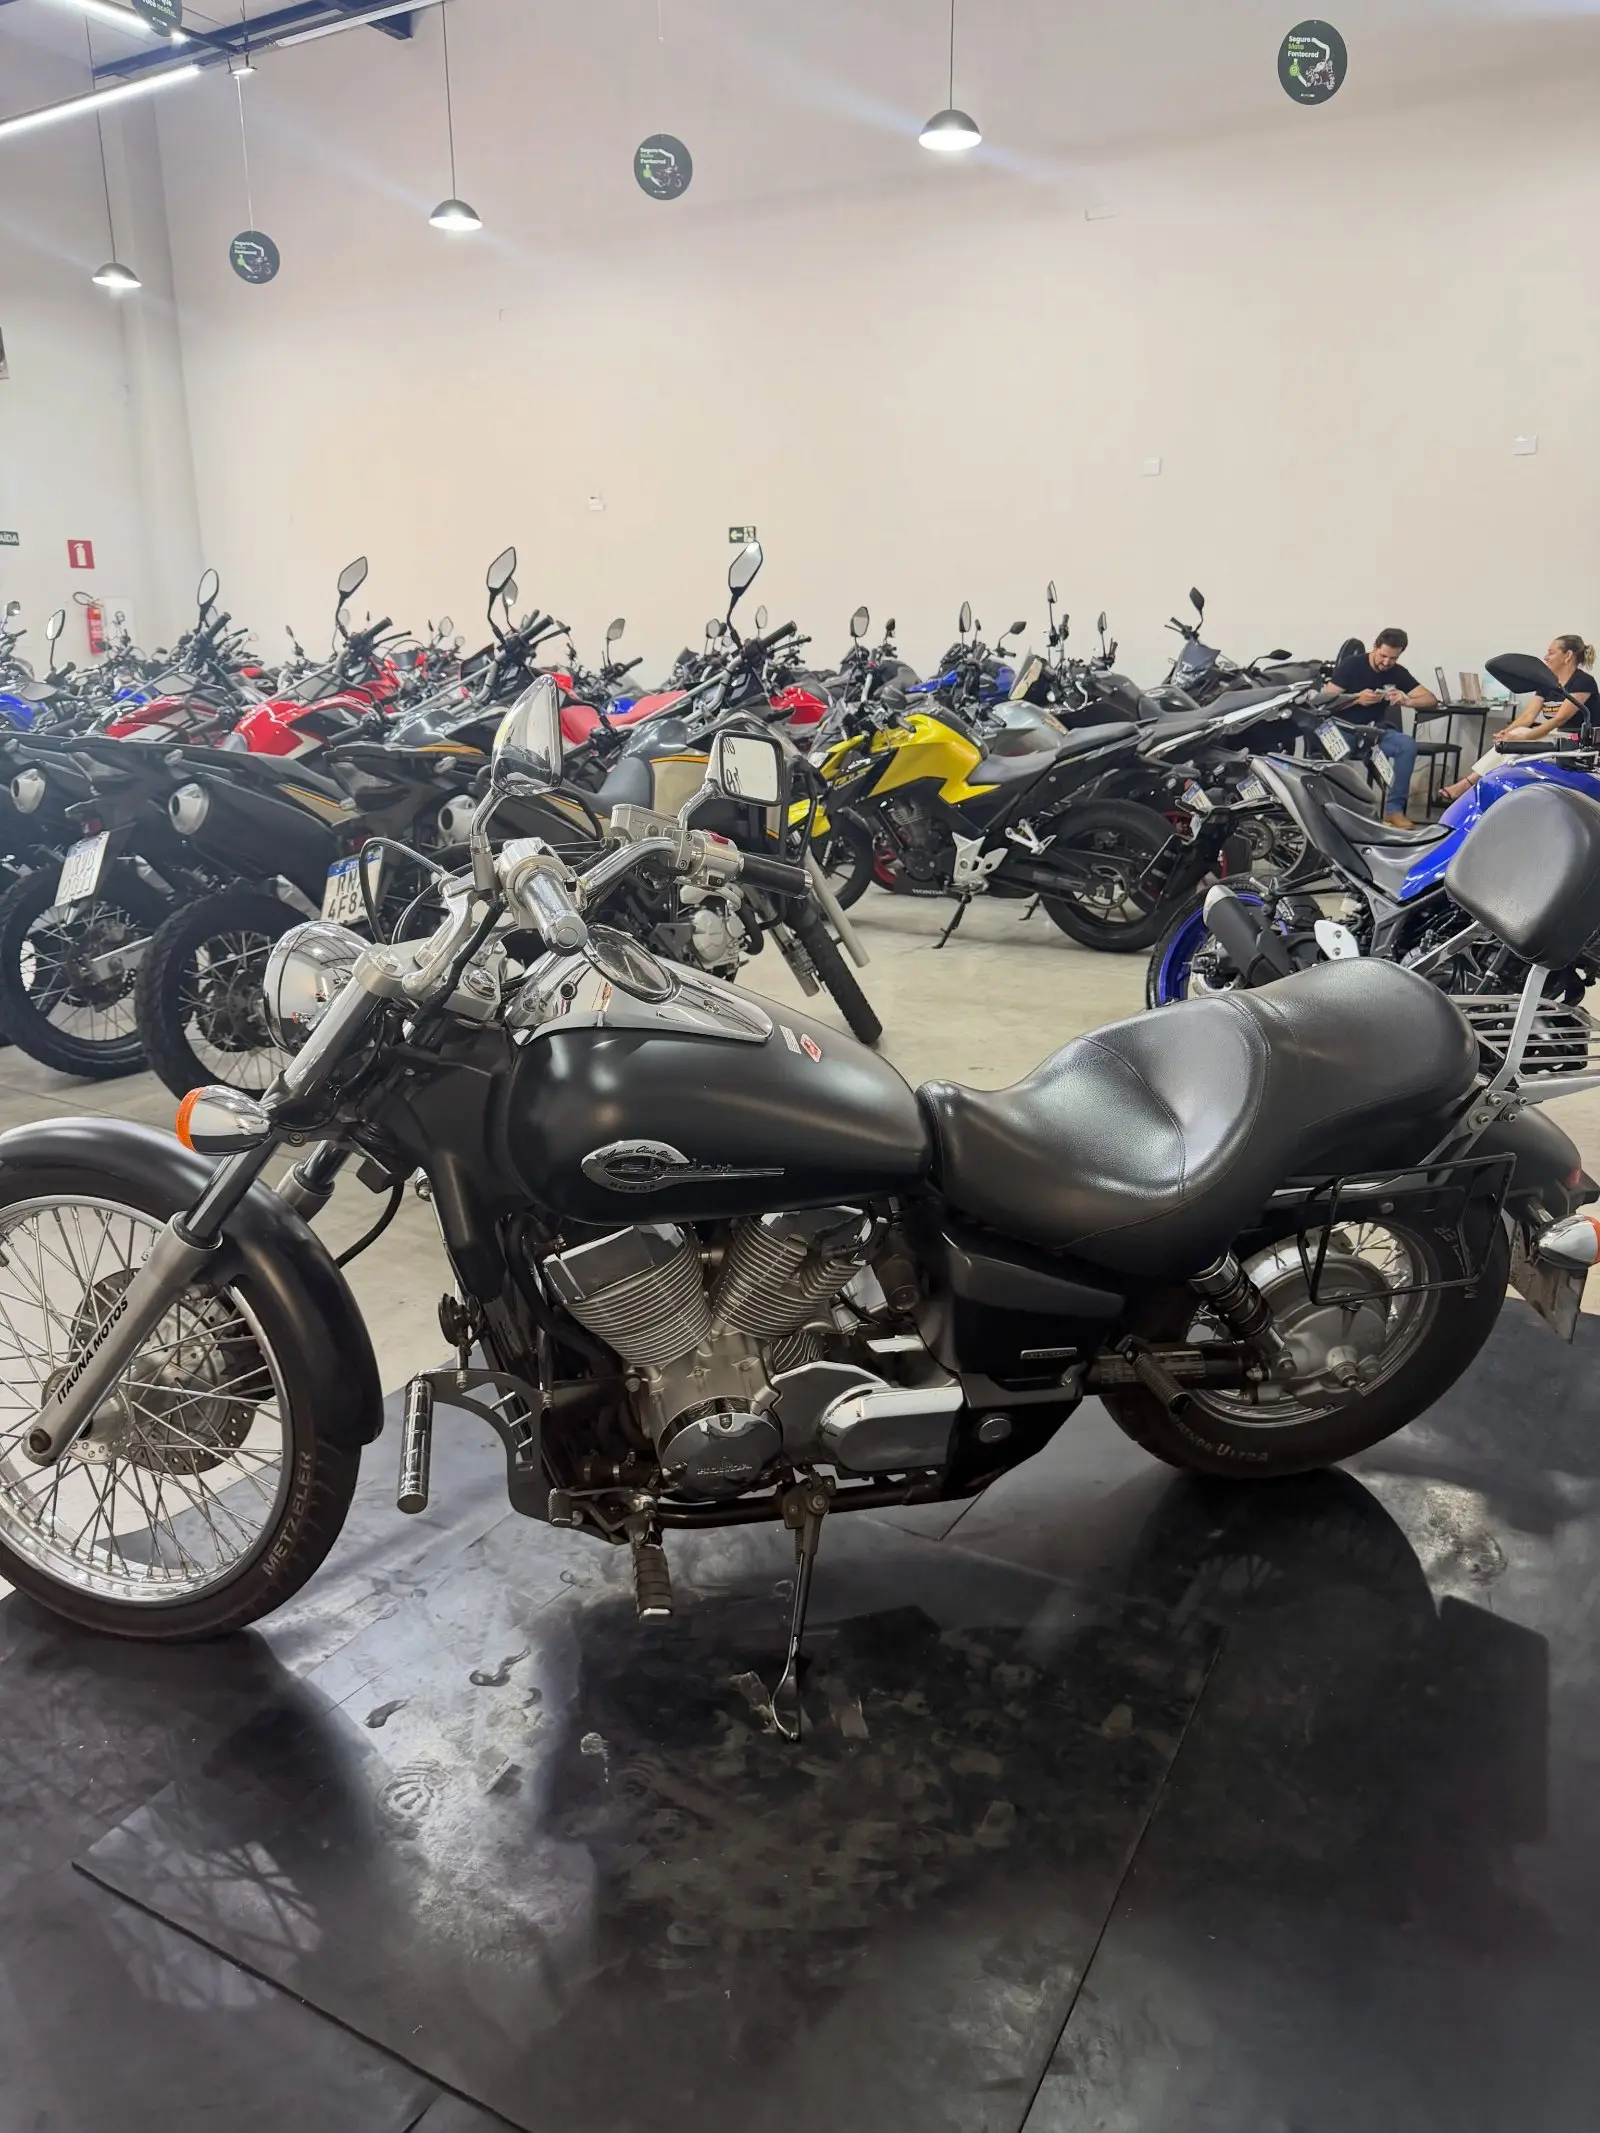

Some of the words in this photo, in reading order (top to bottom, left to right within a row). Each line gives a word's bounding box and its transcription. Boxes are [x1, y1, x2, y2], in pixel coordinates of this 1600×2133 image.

[1288, 36, 1311, 44] Seguro
[0, 532, 18, 543] AÍDA
[609, 1181, 657, 1191] HONDA
[57, 1349, 94, 1404] ITAUNA
[93, 1296, 128, 1351] MOTOS
[261, 1450, 312, 1577] METZELER
